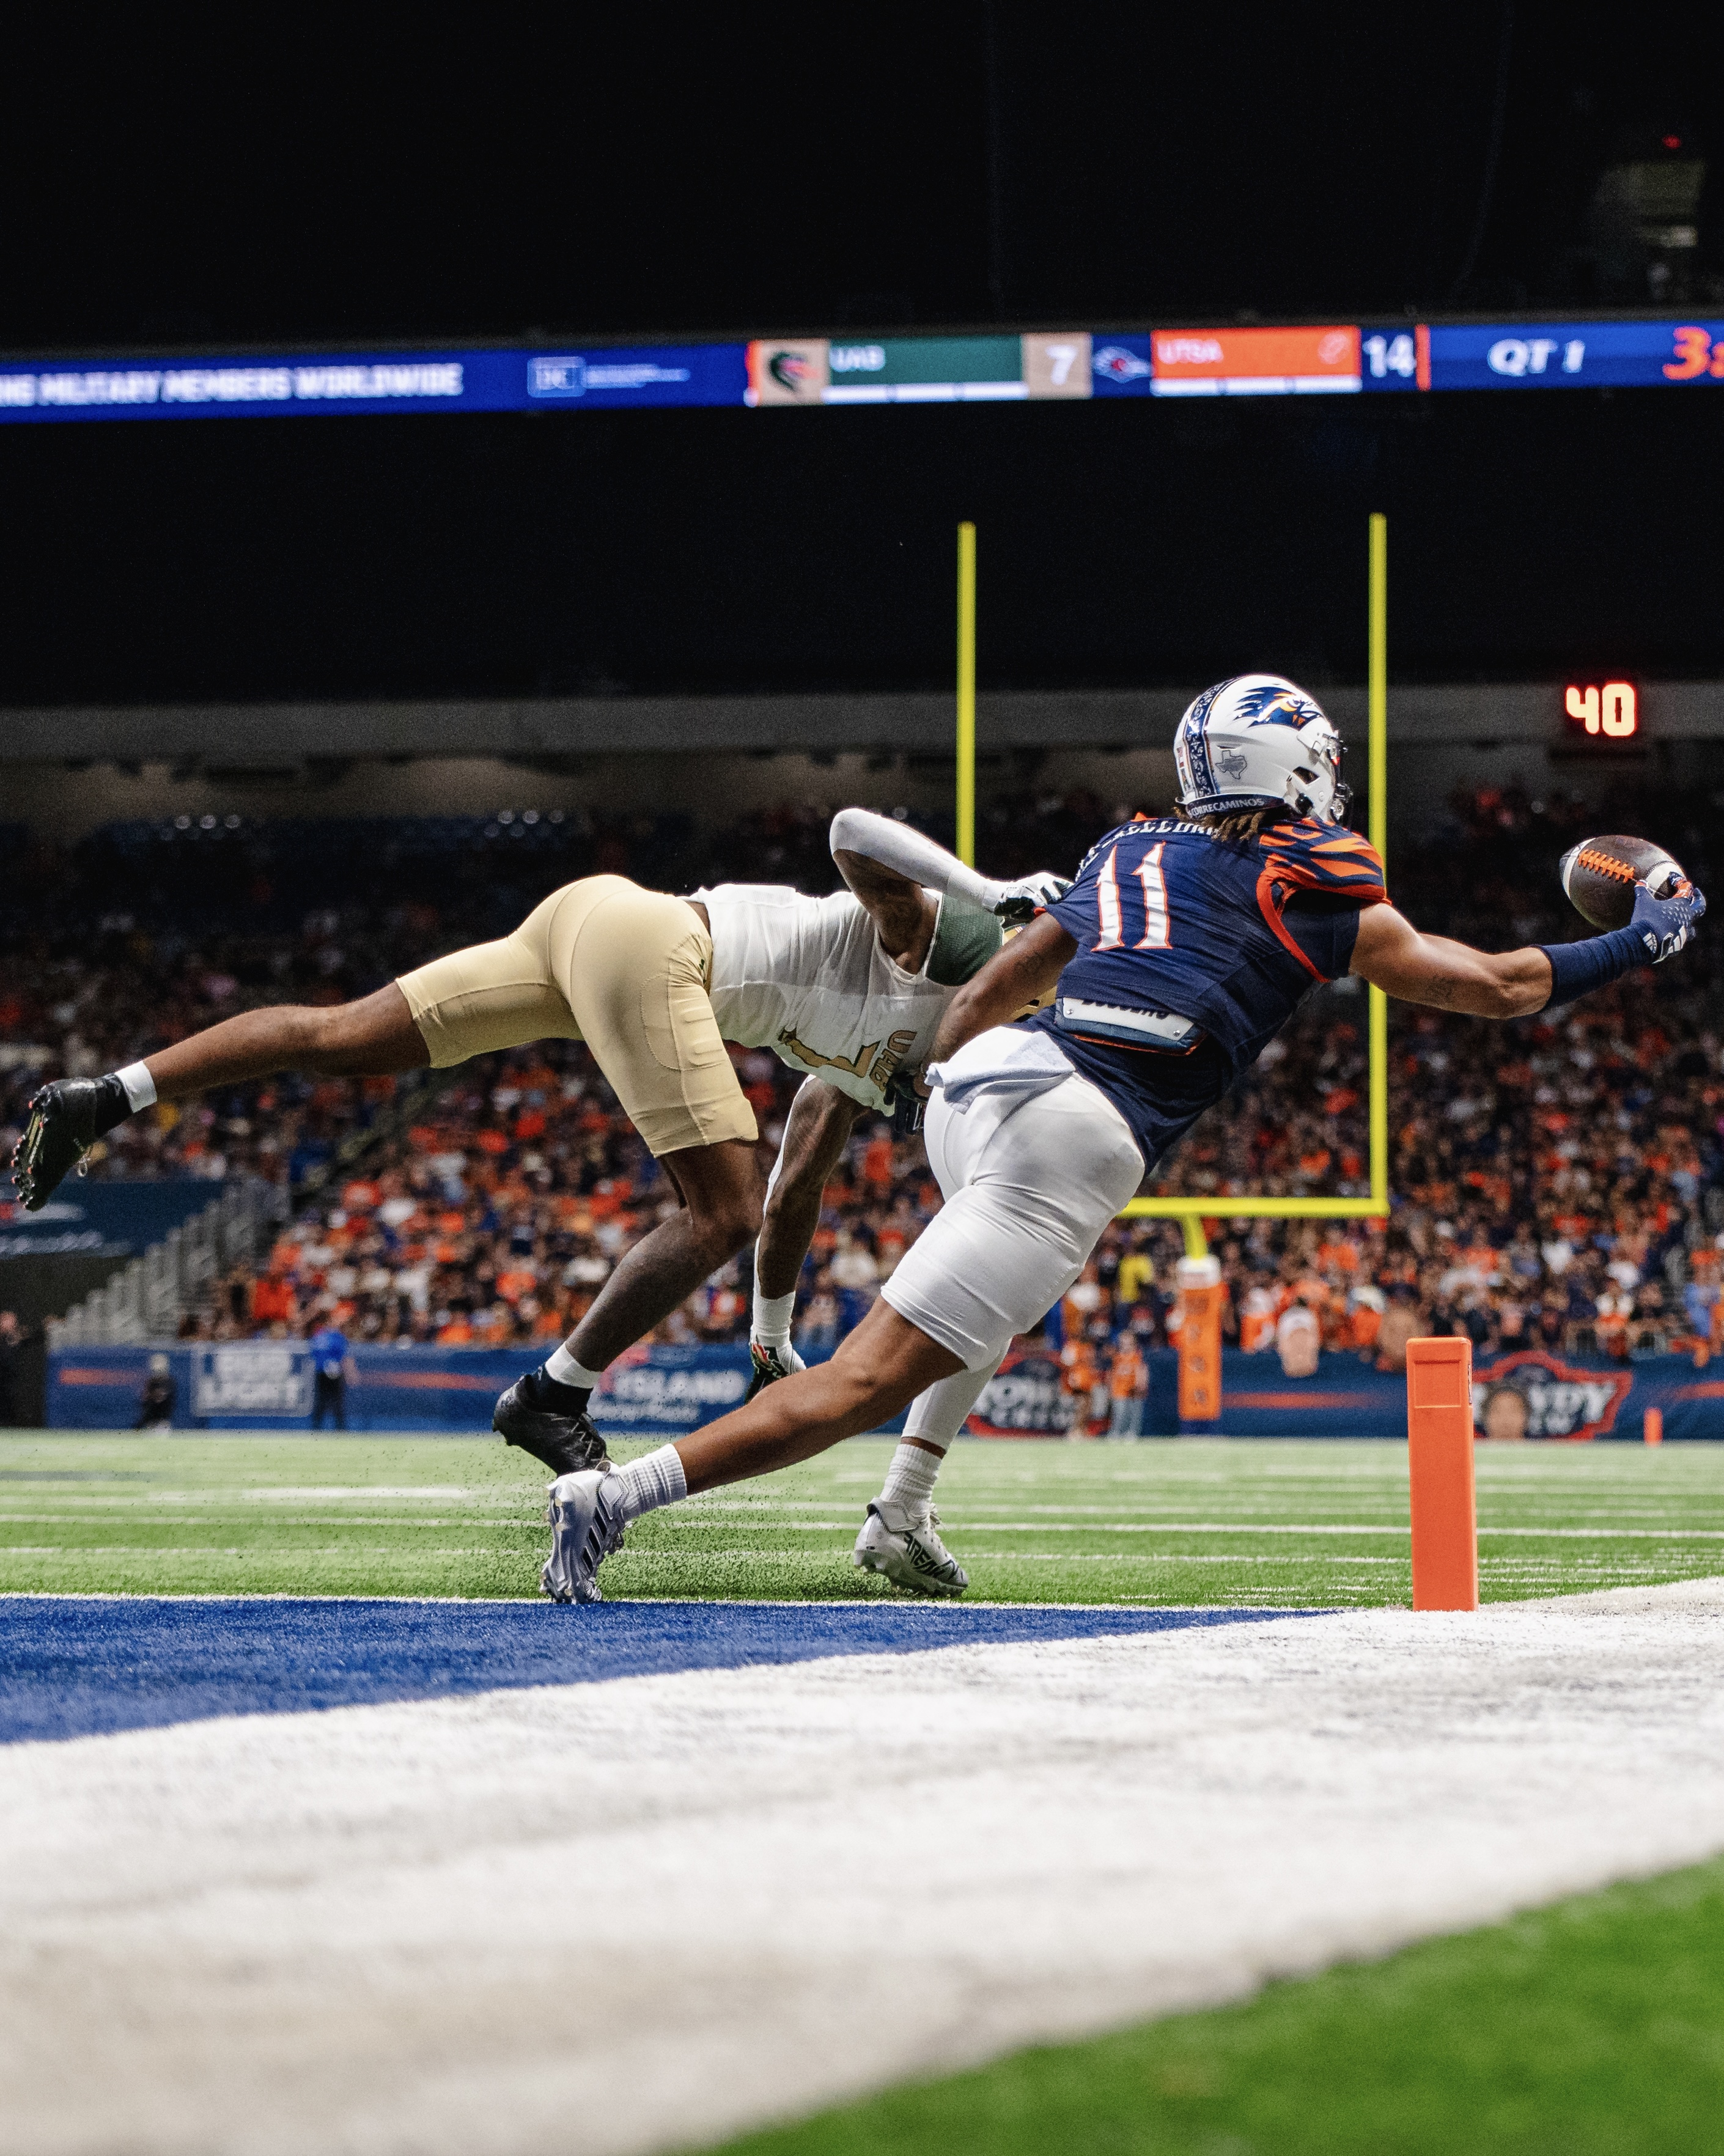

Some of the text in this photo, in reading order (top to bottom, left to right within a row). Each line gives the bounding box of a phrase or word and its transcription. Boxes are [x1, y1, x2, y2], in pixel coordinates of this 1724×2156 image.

[830, 345, 885, 372] UAB
[1045, 344, 1078, 385] 7
[1157, 338, 1223, 365] UTSA
[1362, 334, 1417, 378] 14
[1487, 338, 1558, 377] QT
[40, 371, 159, 406] MILITARY
[162, 367, 292, 404] MEMBERS
[294, 363, 463, 400] WORLDWIDE
[1566, 682, 1637, 737] 40
[1190, 797, 1265, 818] CORRECAMINOS
[1091, 840, 1173, 952] 11
